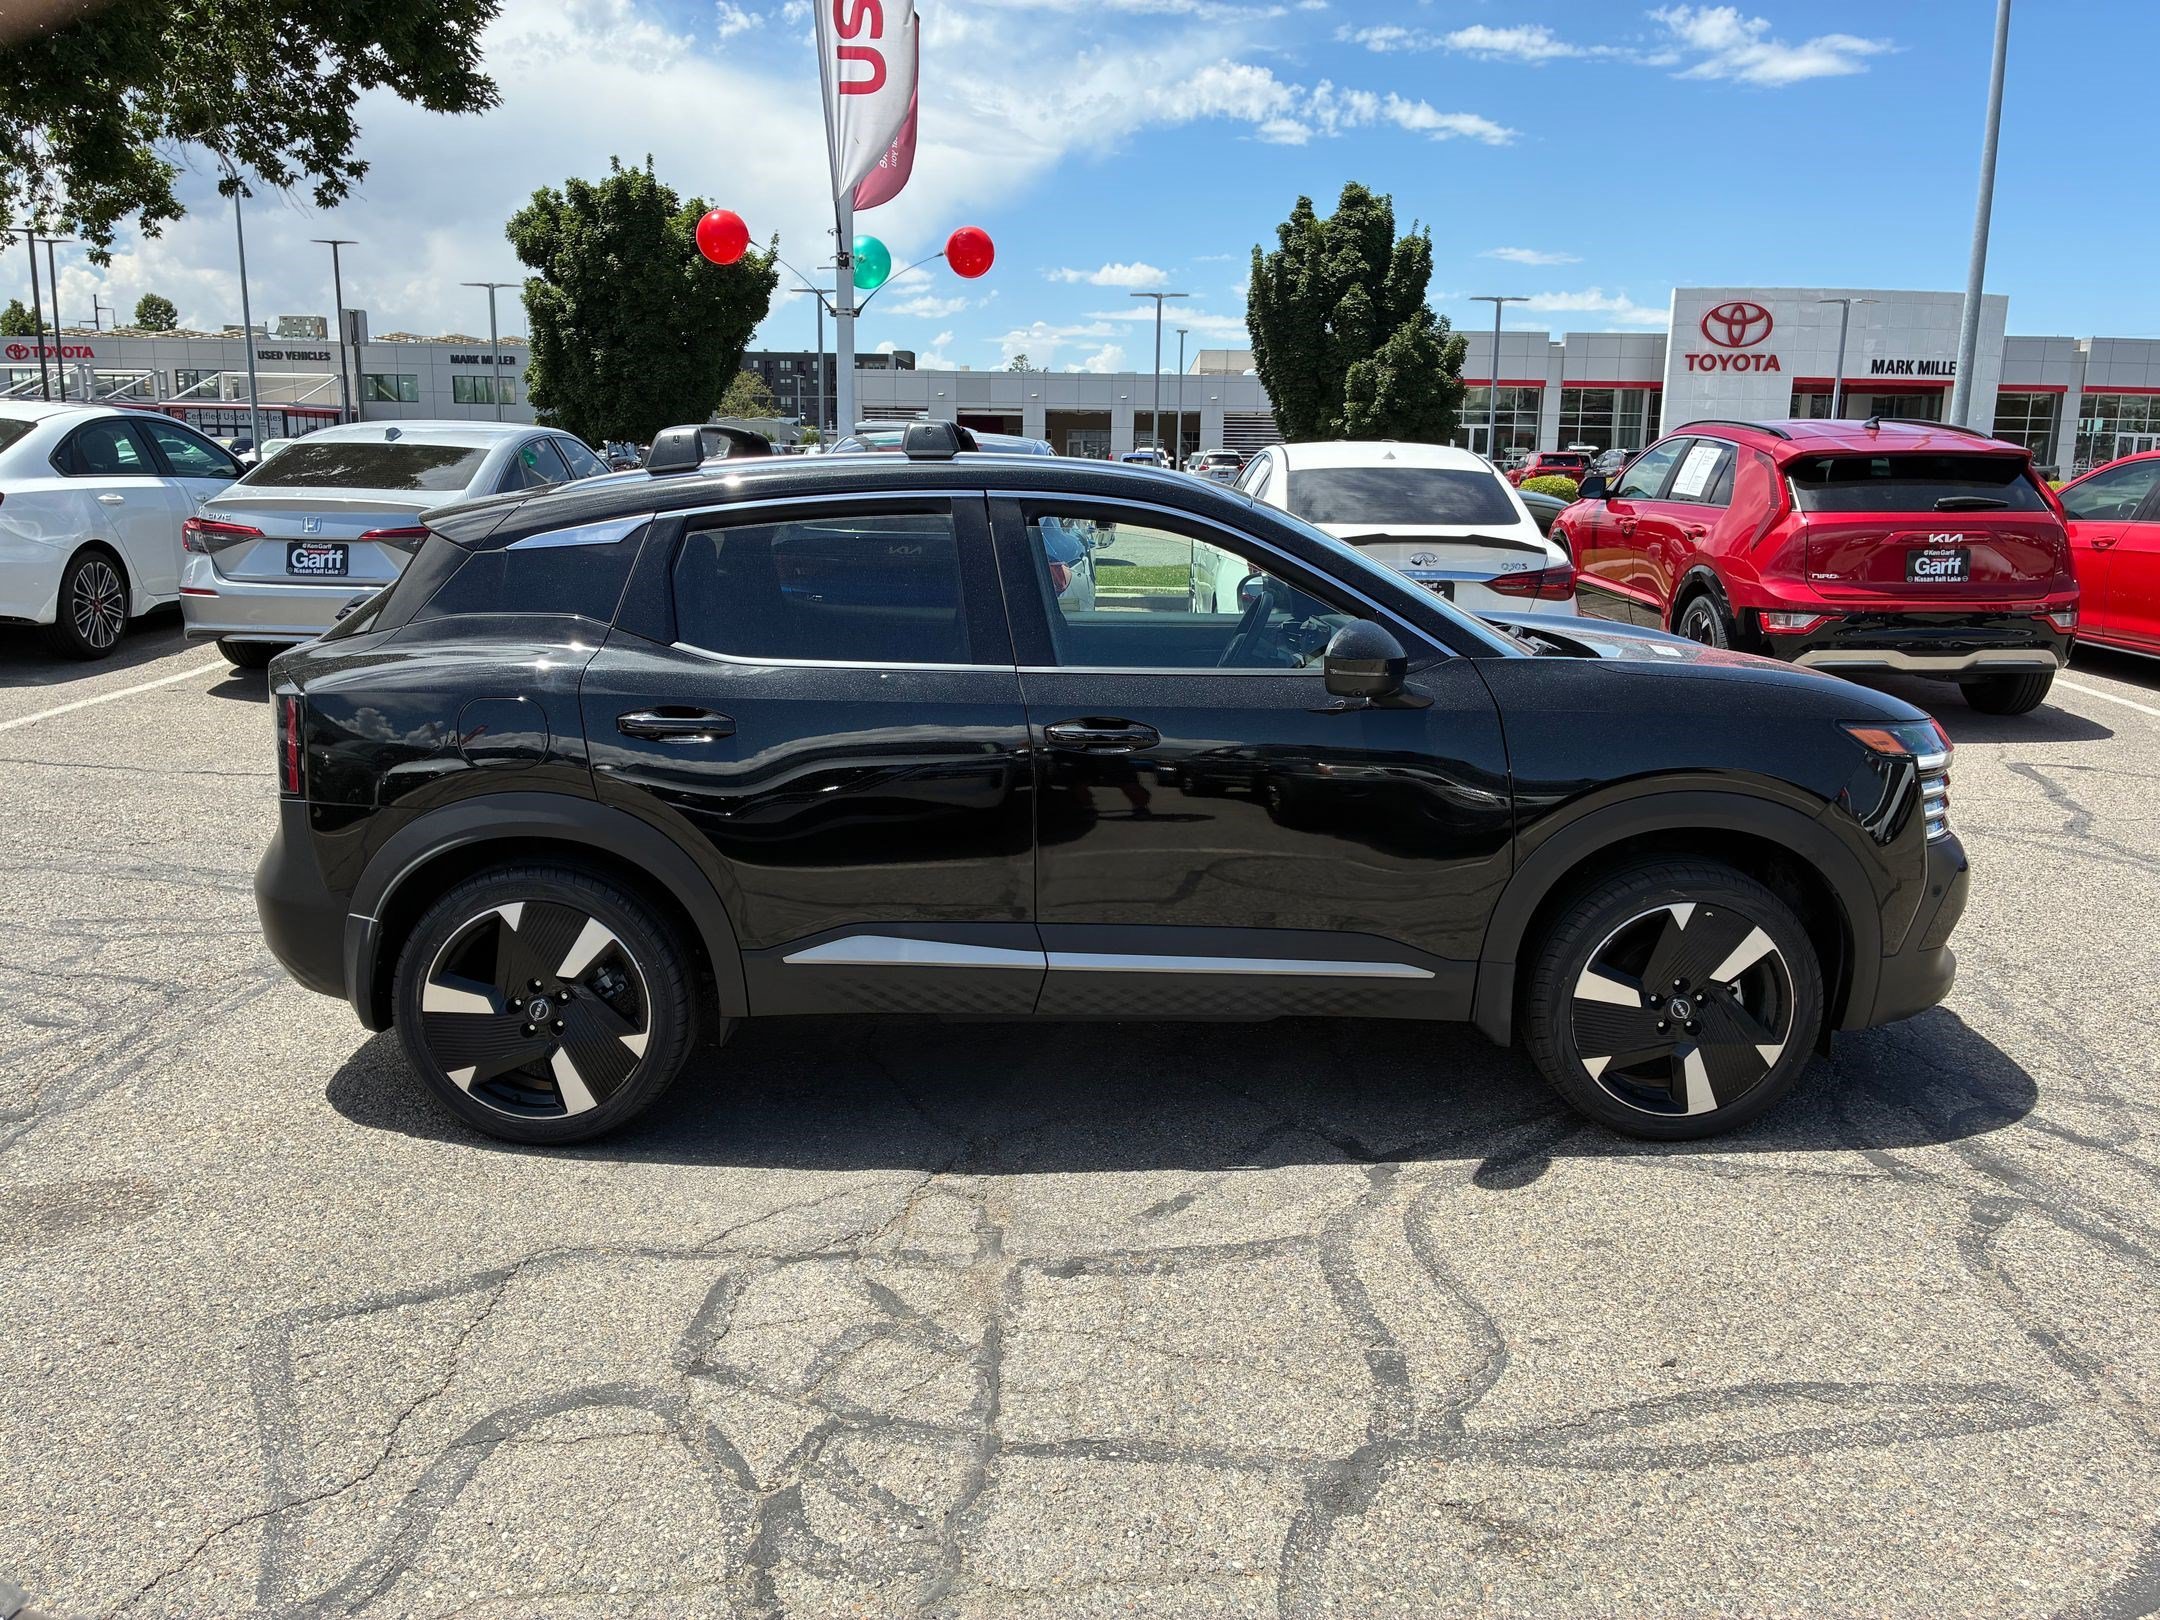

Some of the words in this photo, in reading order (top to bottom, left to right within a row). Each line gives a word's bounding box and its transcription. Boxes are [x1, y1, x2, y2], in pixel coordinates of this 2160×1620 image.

[257, 350, 283, 360] USED
[285, 351, 331, 361] VEHICLES
[450, 354, 479, 364] MARK
[481, 355, 516, 365] MILER
[1685, 353, 1781, 372] TOYOTA
[1870, 359, 1915, 375] MARK
[1917, 360, 1957, 376] MILLE
[223, 412, 246, 421] Used
[1928, 533, 1964, 543] KIA
[291, 548, 343, 568] Garff
[1914, 557, 1962, 575] Garff
